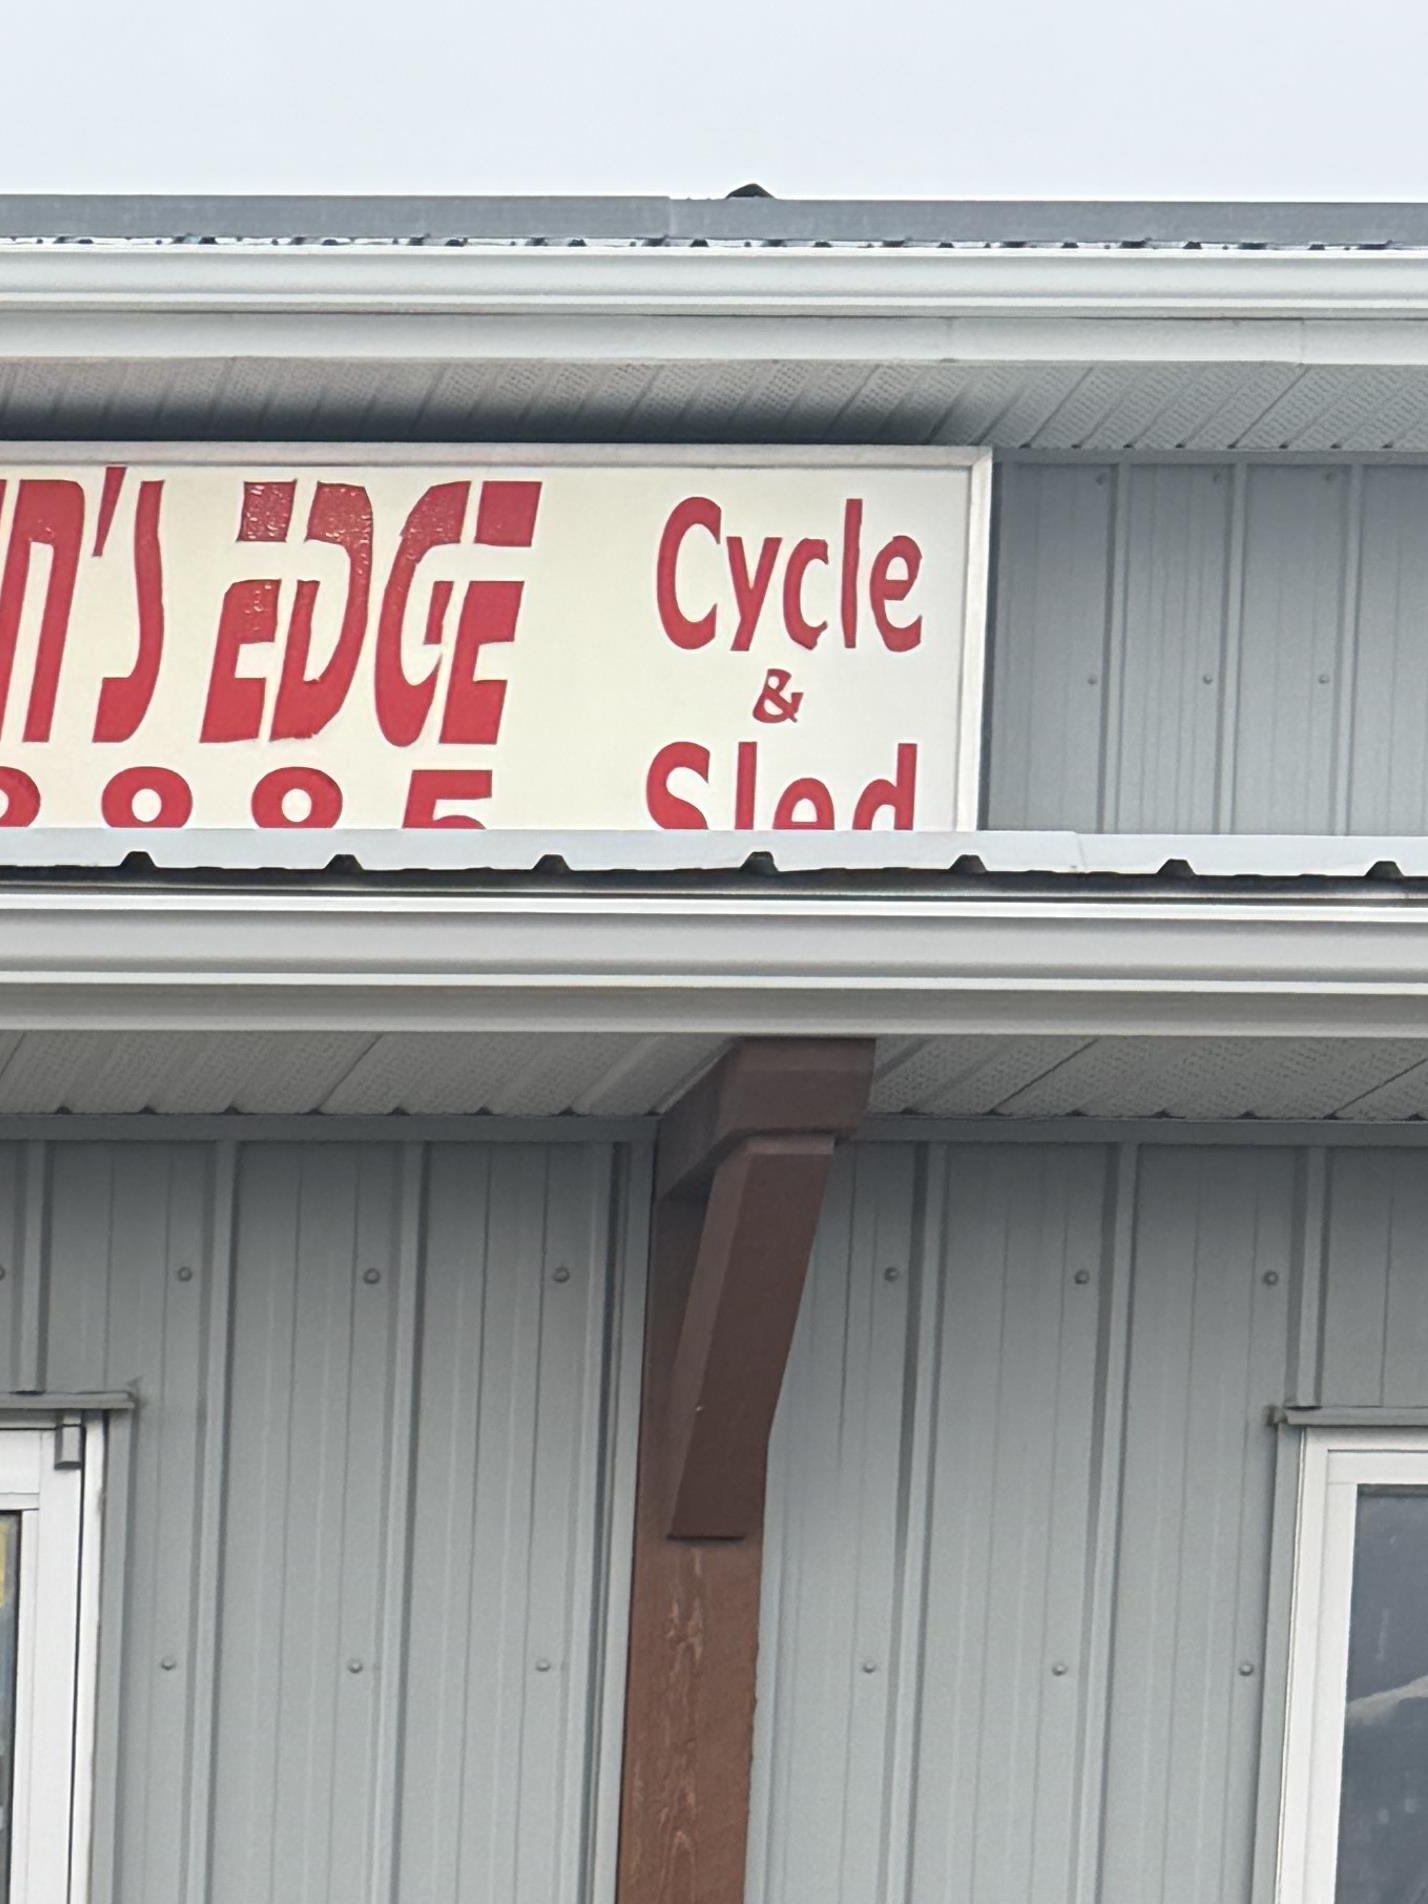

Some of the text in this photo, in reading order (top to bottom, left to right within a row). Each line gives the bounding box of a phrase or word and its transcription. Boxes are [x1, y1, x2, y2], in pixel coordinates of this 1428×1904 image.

[201, 478, 543, 748] EDGE
[657, 496, 923, 653] Cycle
[752, 668, 804, 724] &
